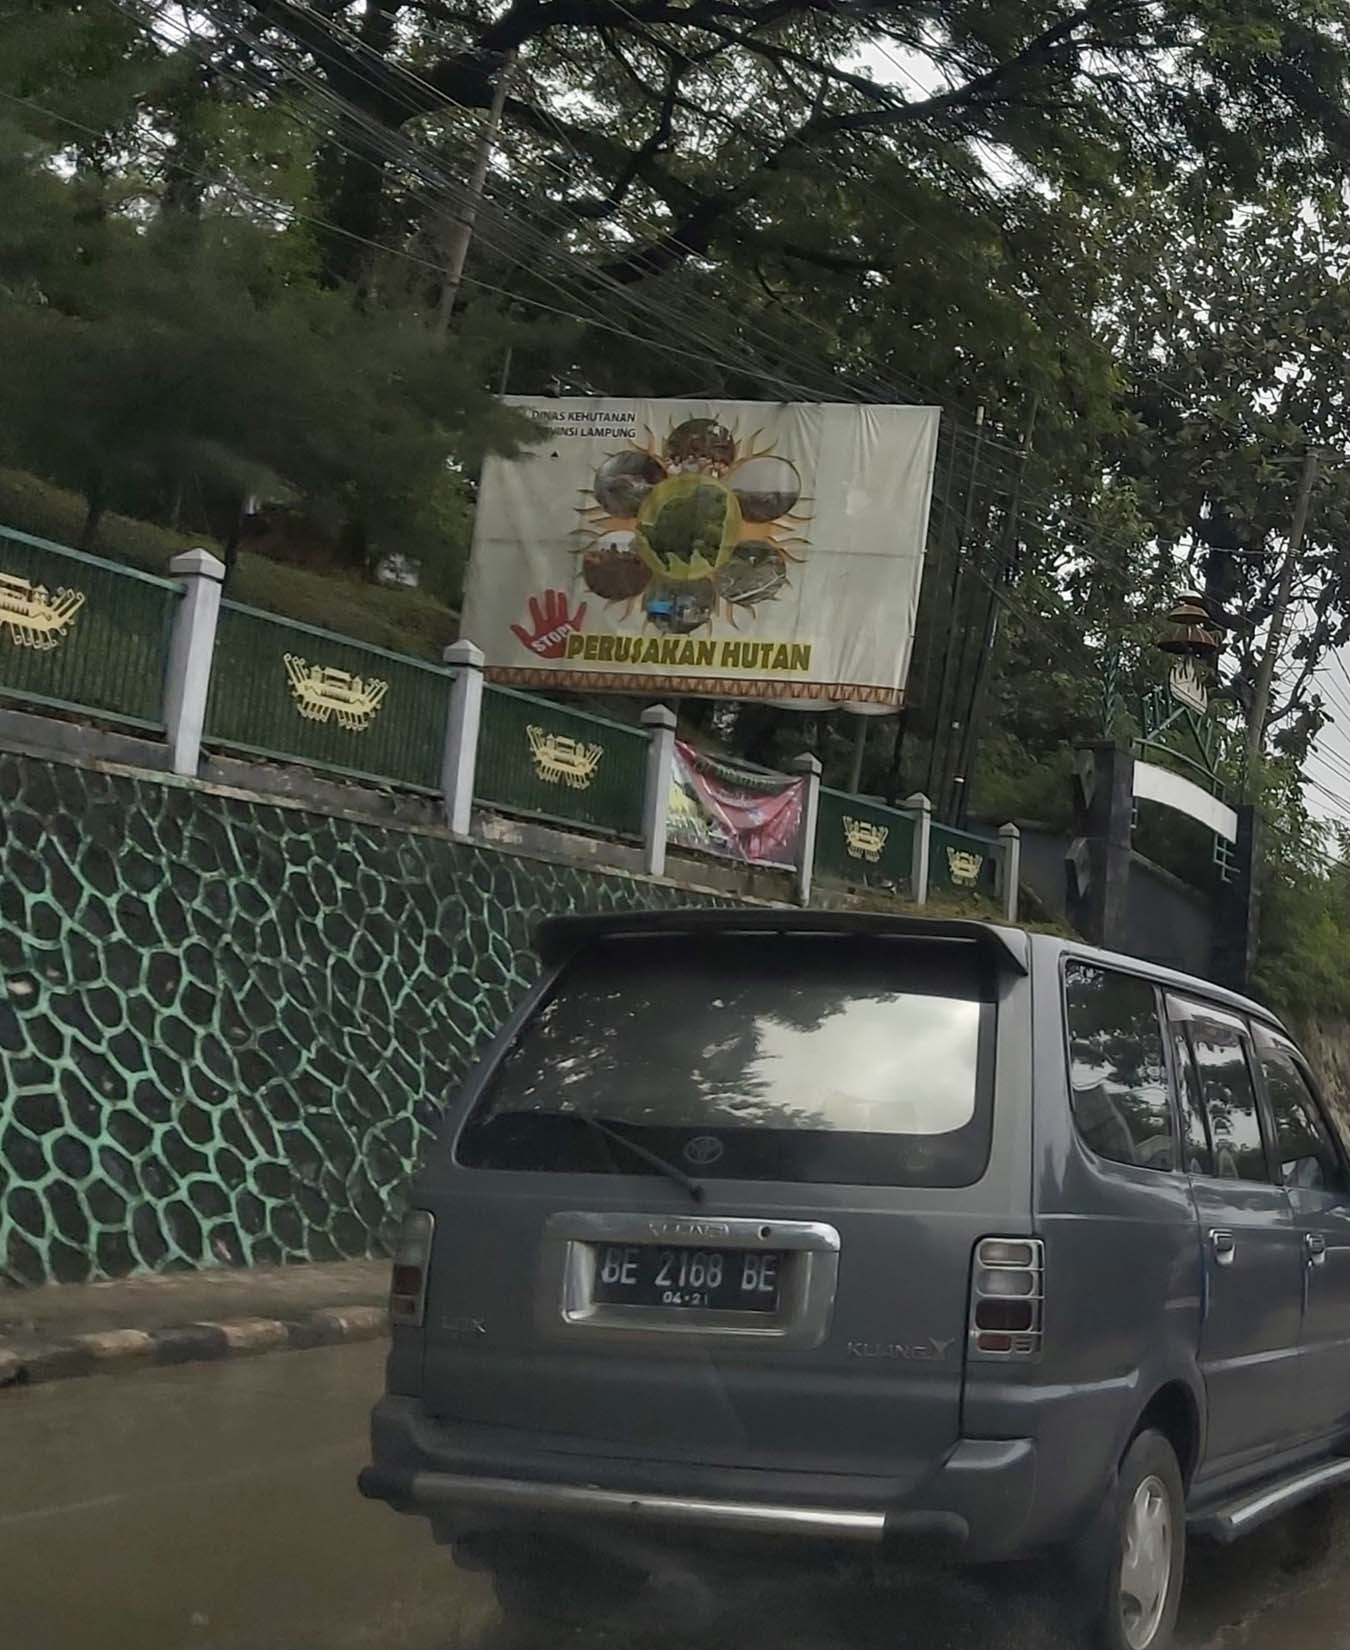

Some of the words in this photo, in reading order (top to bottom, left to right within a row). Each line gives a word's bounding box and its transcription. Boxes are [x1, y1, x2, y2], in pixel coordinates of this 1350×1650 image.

[567, 411, 636, 422] KEHUTANAN
[580, 427, 637, 438] LAMPUNG
[531, 622, 574, 652] STOP!
[566, 634, 717, 667] PERUSAKAN
[719, 641, 813, 671] HUTAN
[601, 1247, 639, 1285] BE
[654, 1251, 724, 1288] 2168
[740, 1254, 777, 1292] BE
